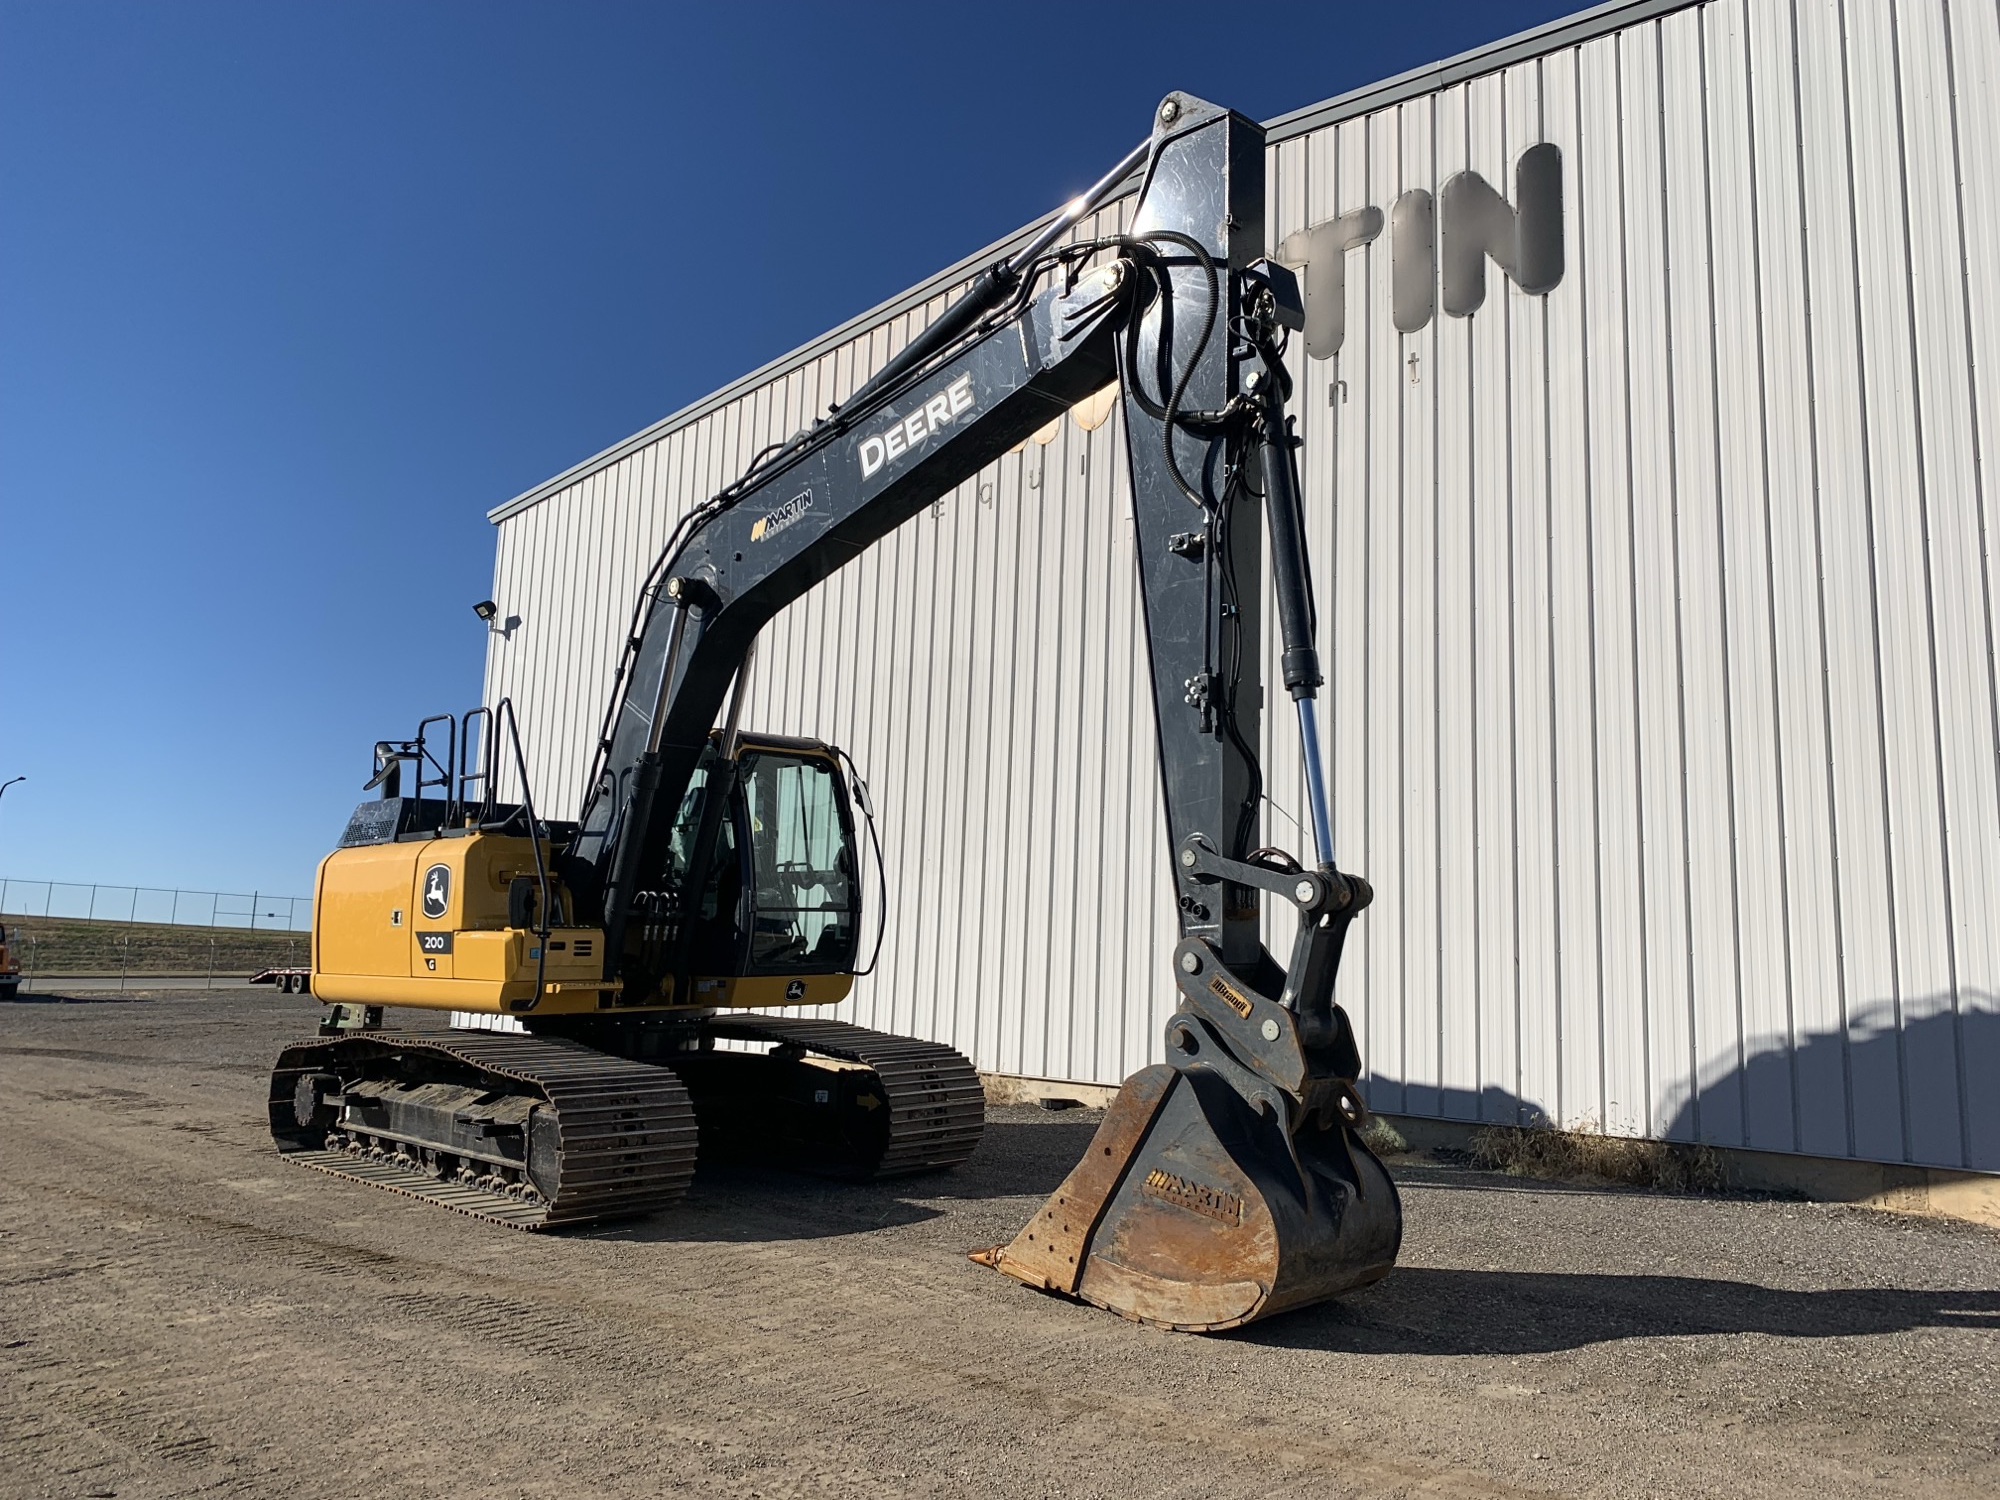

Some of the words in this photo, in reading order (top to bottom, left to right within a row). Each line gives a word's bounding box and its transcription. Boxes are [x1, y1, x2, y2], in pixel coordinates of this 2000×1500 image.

[859, 374, 973, 478] DEERE
[764, 489, 812, 533] MARTIN
[424, 936, 444, 949] 200
[428, 959, 435, 970] G
[1215, 981, 1248, 1013] Brandt
[1165, 1173, 1241, 1217] MARTIN
